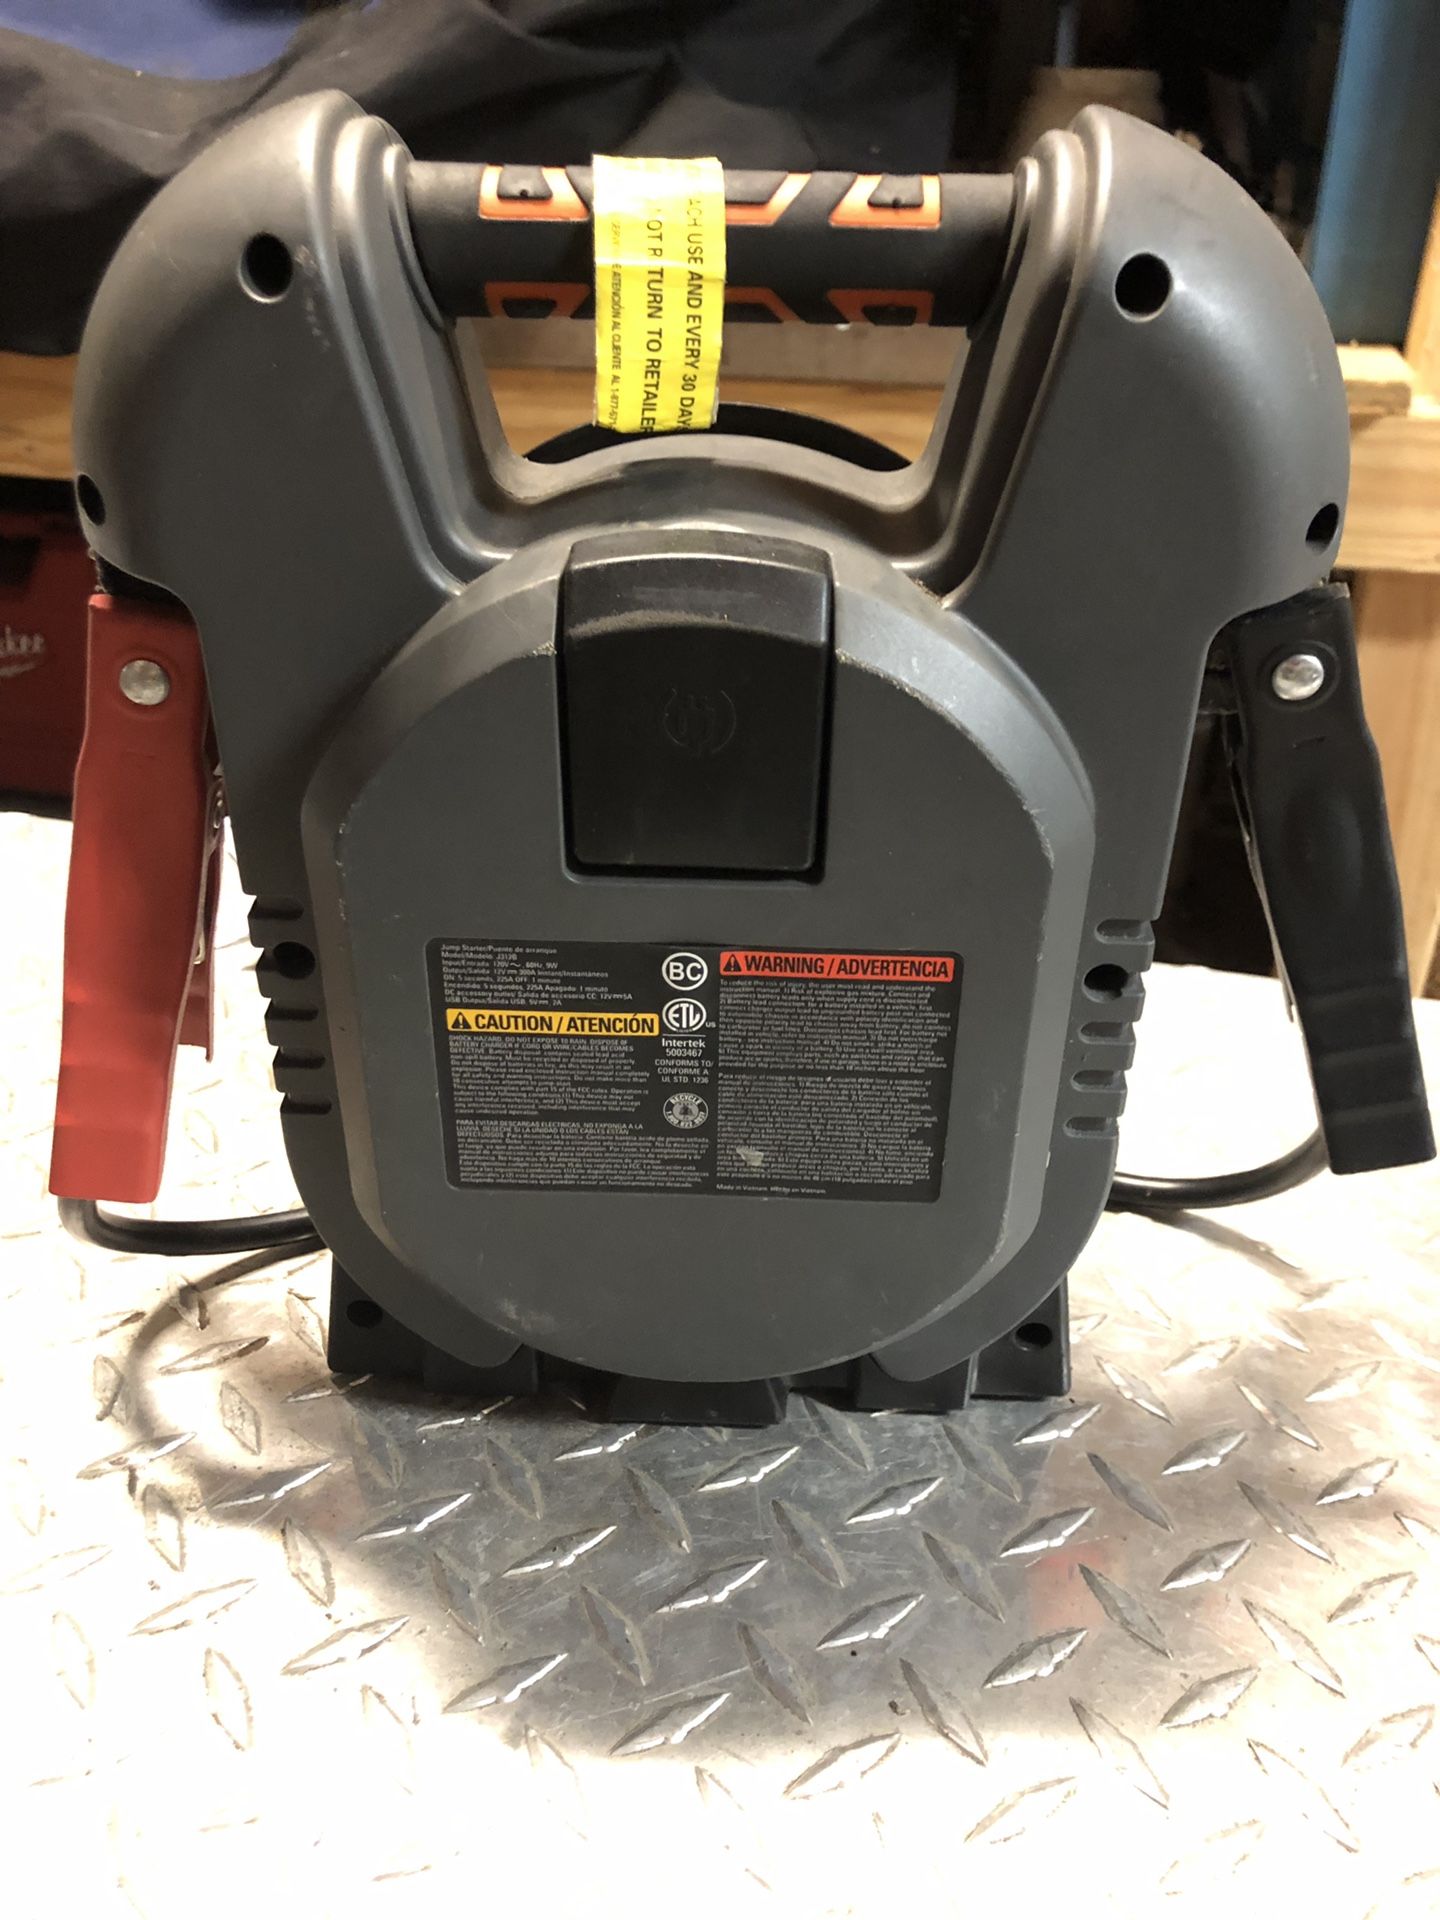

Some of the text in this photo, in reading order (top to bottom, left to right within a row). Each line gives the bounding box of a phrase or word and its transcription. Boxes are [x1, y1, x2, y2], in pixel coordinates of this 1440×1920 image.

[687, 233, 703, 265] USE
[646, 246, 664, 320] RTURN
[686, 269, 703, 309] AND
[611, 320, 622, 334] AL
[646, 330, 663, 354] TO
[684, 313, 702, 370] EVERY
[681, 373, 697, 392] 30
[668, 961, 702, 981] BC
[744, 955, 825, 975] WARNING
[836, 958, 949, 978] ADVERTENCIA
[474, 1013, 554, 1031] CAUTION
[566, 1012, 655, 1034] ATENCIÓN
[668, 1003, 701, 1029] ETL
[661, 1038, 706, 1049] Intertek
[665, 1048, 703, 1058] 5003467
[654, 1059, 699, 1067] CONFORMS
[657, 1067, 701, 1075] CONFORME
